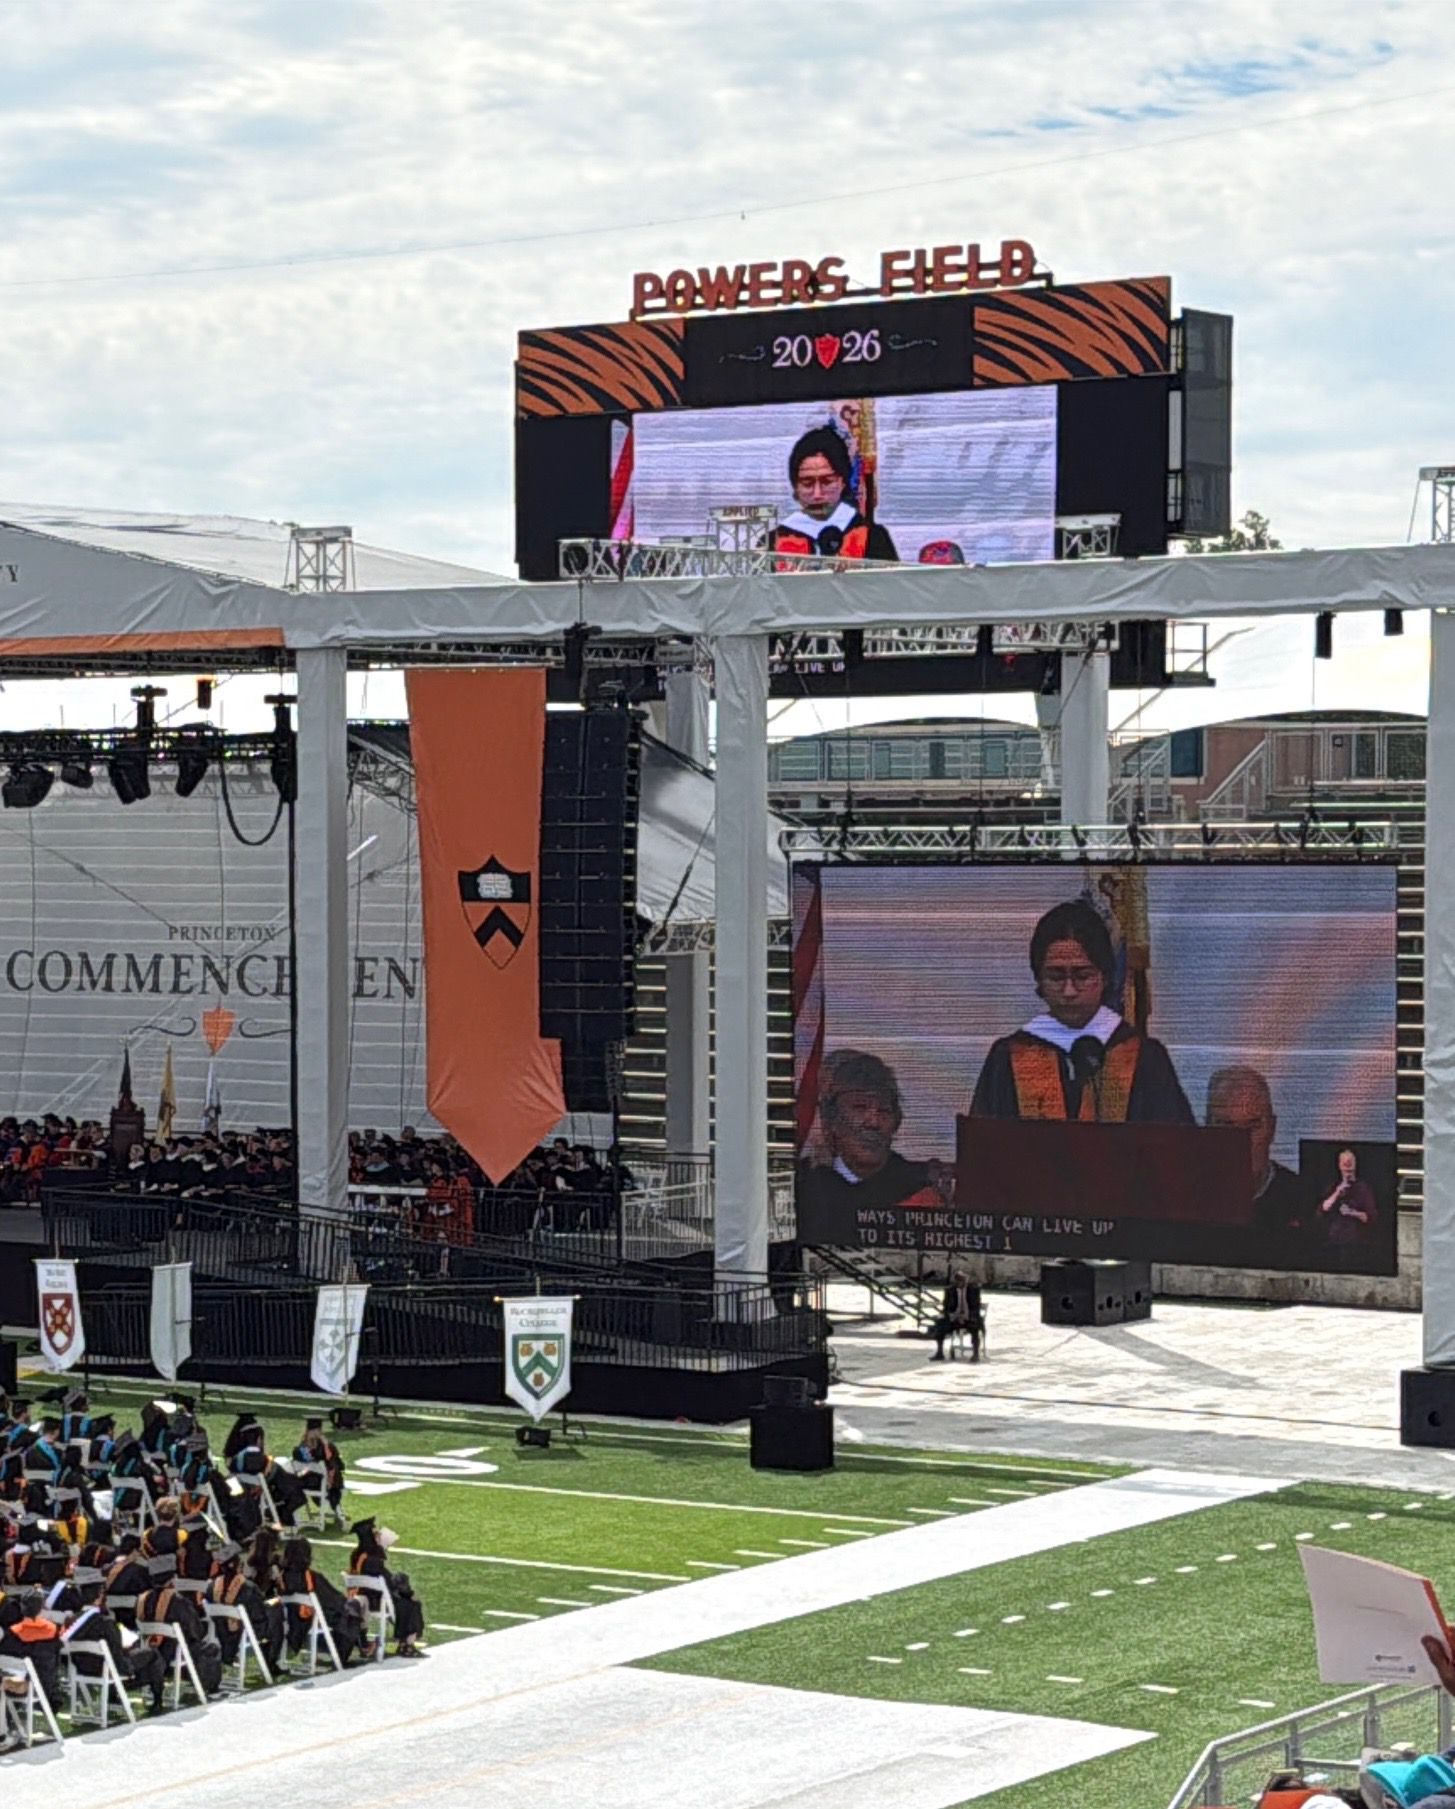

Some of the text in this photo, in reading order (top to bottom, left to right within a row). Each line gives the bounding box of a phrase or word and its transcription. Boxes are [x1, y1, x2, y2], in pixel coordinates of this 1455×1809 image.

[632, 240, 1036, 315] POWERS FIELD
[773, 330, 882, 367] 20 26
[168, 925, 278, 942] PRINCETON
[5, 949, 425, 1000] COMMENCEEN
[857, 1209, 897, 1225] WAYS
[1001, 1215, 1033, 1232] CAN
[1043, 1218, 1083, 1234] LIVE
[1091, 1220, 1115, 1235] UP
[857, 1228, 878, 1244] TO
[886, 1230, 917, 1246] ITS
[924, 1231, 992, 1250] HIGHEST
